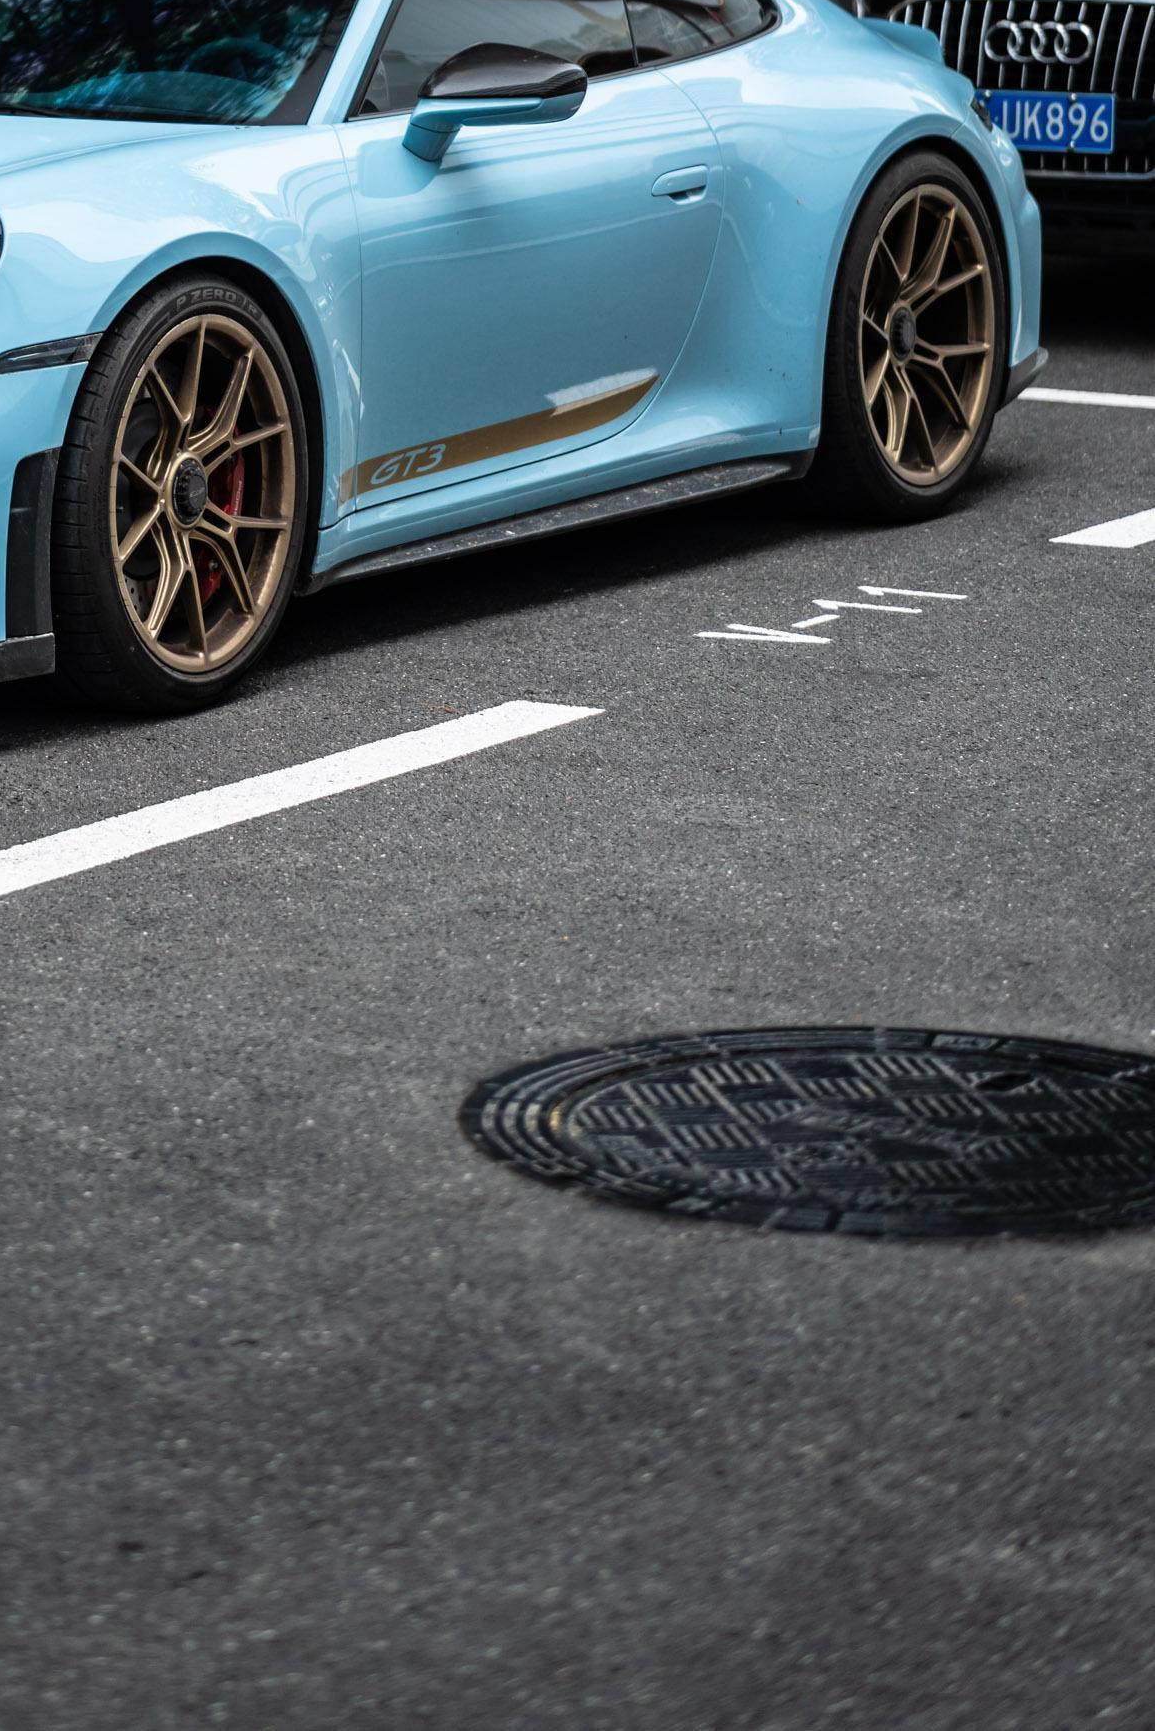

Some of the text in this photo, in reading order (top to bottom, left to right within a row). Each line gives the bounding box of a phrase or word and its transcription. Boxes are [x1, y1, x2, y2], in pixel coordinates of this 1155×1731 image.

[175, 295, 187, 311] P
[190, 287, 237, 303] ZERO
[369, 442, 447, 485] GT3
